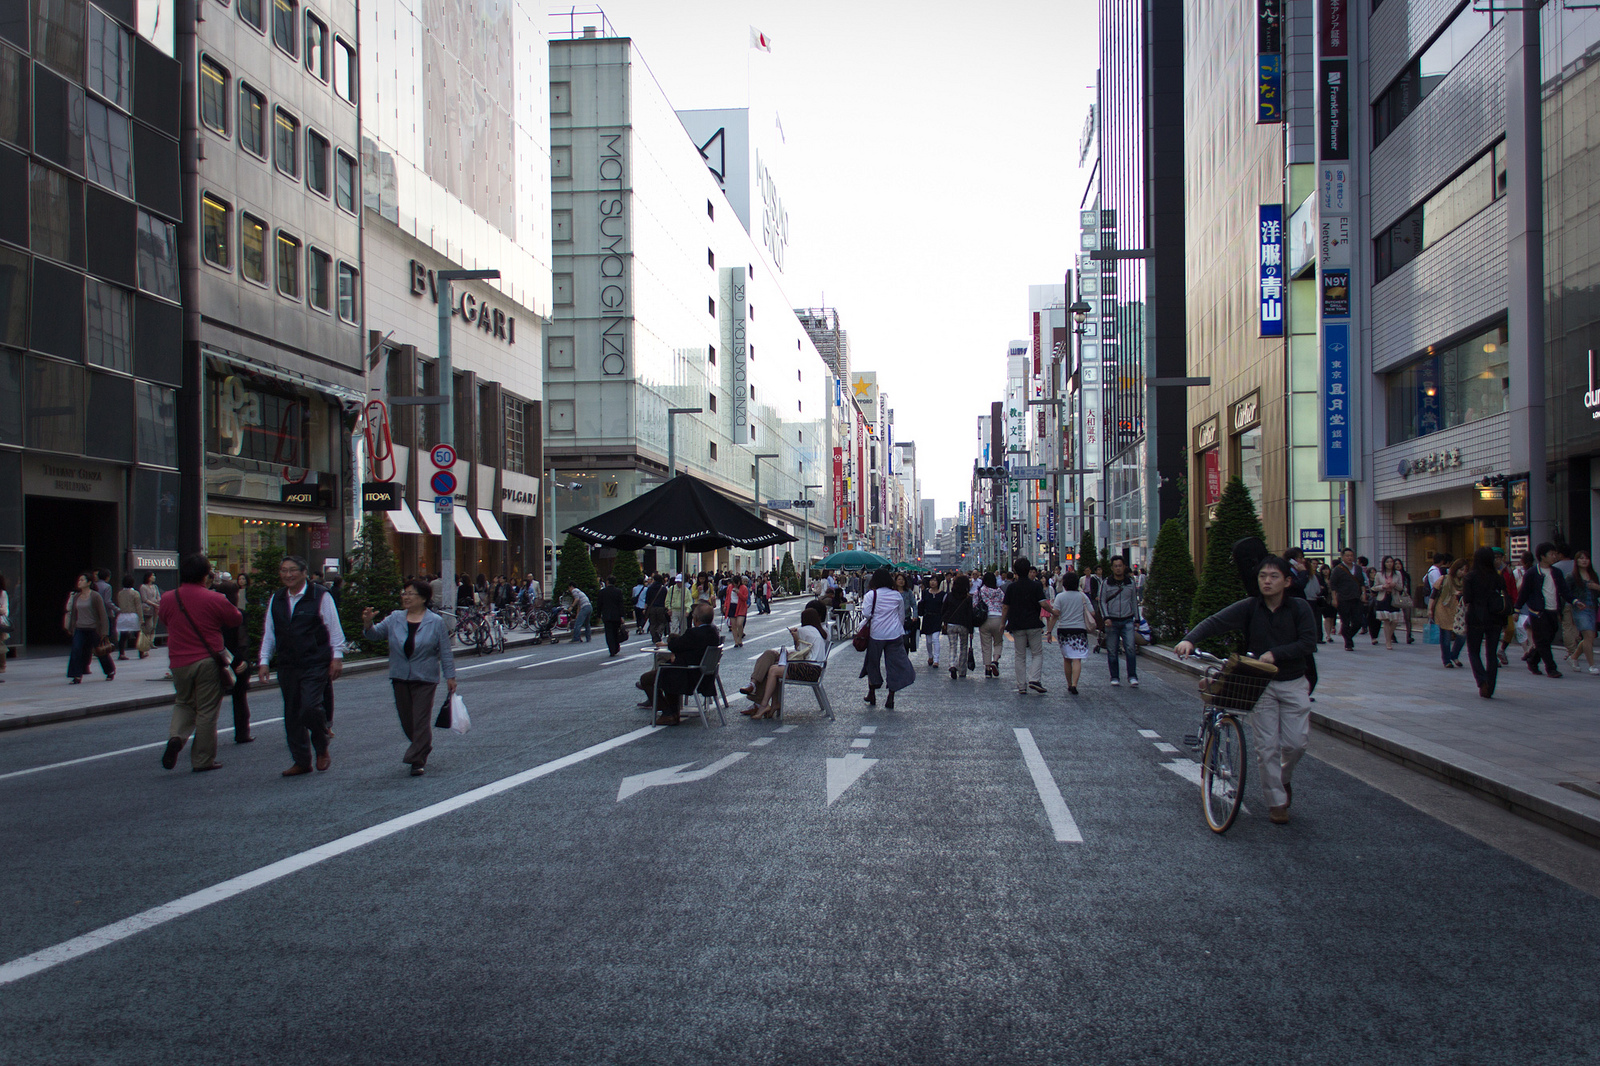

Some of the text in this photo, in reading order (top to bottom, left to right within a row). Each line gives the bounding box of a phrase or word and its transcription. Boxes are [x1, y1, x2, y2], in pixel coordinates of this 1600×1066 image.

[1330, 86, 1339, 151] Franklin Planner
[1260, 220, 1282, 321] 洋服の青山
[1324, 277, 1347, 286] N9Y
[1234, 401, 1257, 430] Cartier
[1086, 409, 1096, 444] 大和証券
[1198, 424, 1216, 448] Cartier
[436, 450, 450, 463] 50
[454, 493, 467, 501] GARI
[502, 488, 537, 505] BVLGARI
[578, 526, 607, 540] ALFRED
[630, 526, 668, 541] ALFRED
[671, 529, 711, 542] DUNHILL
[742, 532, 779, 544] DUNHILL
[1302, 539, 1324, 550] 青山
